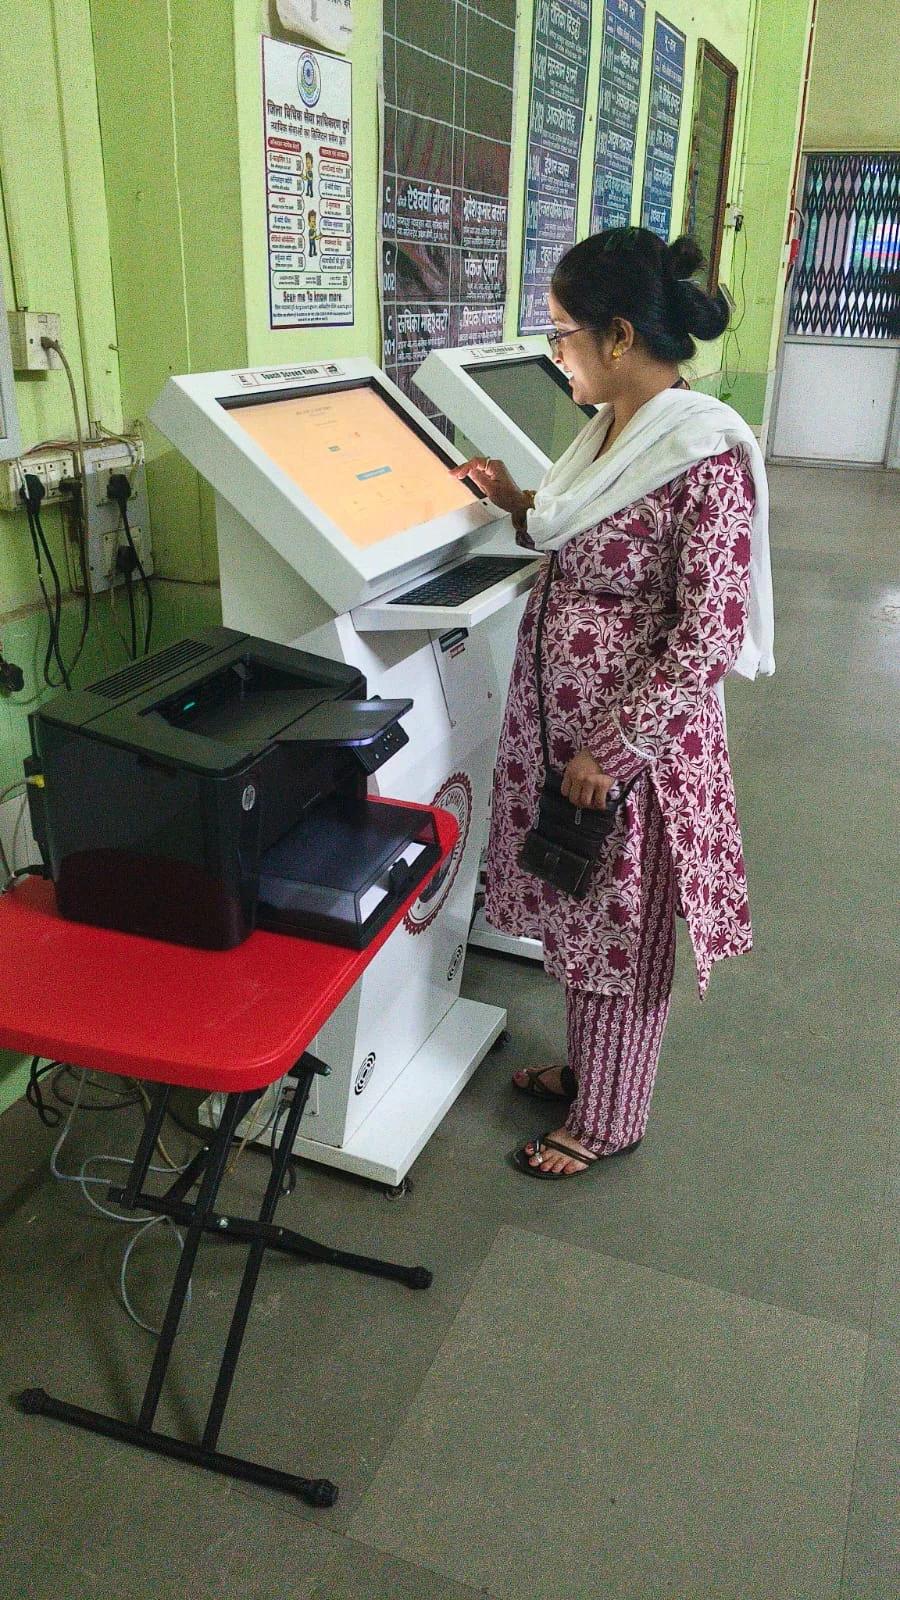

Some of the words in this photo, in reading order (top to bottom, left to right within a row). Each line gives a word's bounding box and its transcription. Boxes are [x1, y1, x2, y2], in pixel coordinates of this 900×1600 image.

[267, 99, 283, 117] जिला
[284, 103, 302, 120] विधिक
[304, 108, 315, 124] सेवा
[316, 112, 341, 131] प्राधिकरण
[342, 118, 350, 135] दुर्ग
[464, 252, 483, 277] पंकज
[283, 290, 296, 302] Scan
[297, 294, 305, 302] me
[314, 290, 327, 302] know
[329, 293, 341, 302] more
[281, 369, 302, 378] Screen
